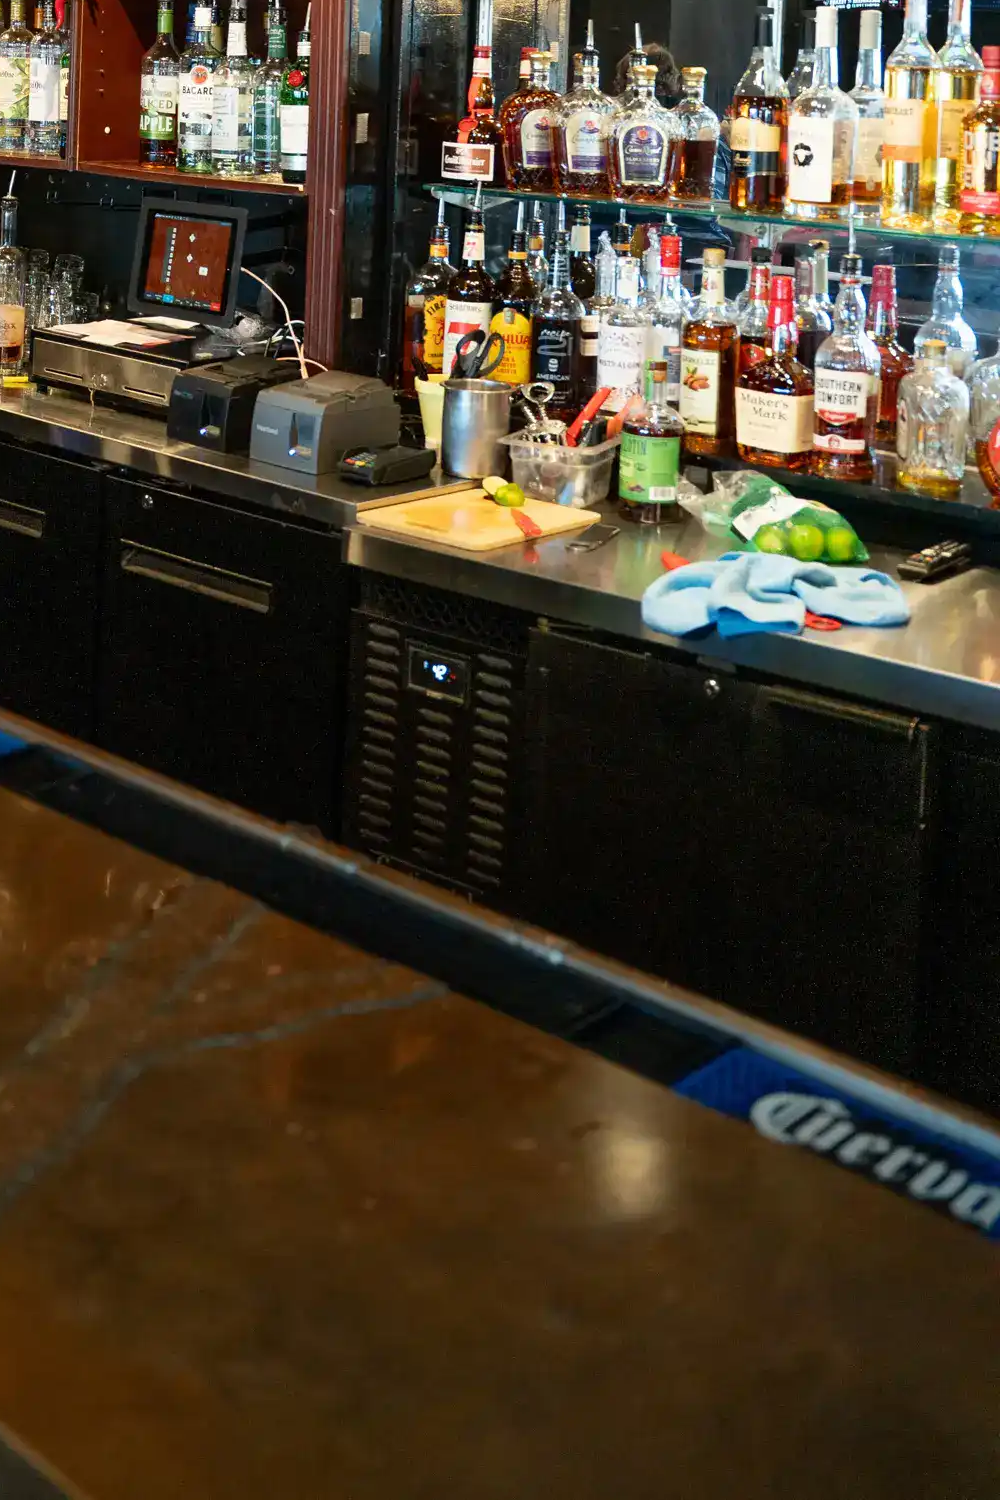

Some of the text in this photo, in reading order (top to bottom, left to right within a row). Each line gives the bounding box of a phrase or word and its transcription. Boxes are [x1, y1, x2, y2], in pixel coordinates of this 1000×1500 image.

[140, 116, 172, 131] APPLE
[536, 373, 570, 381] AMERICAN
[740, 392, 789, 409] Maker's
[753, 406, 789, 421] Mark
